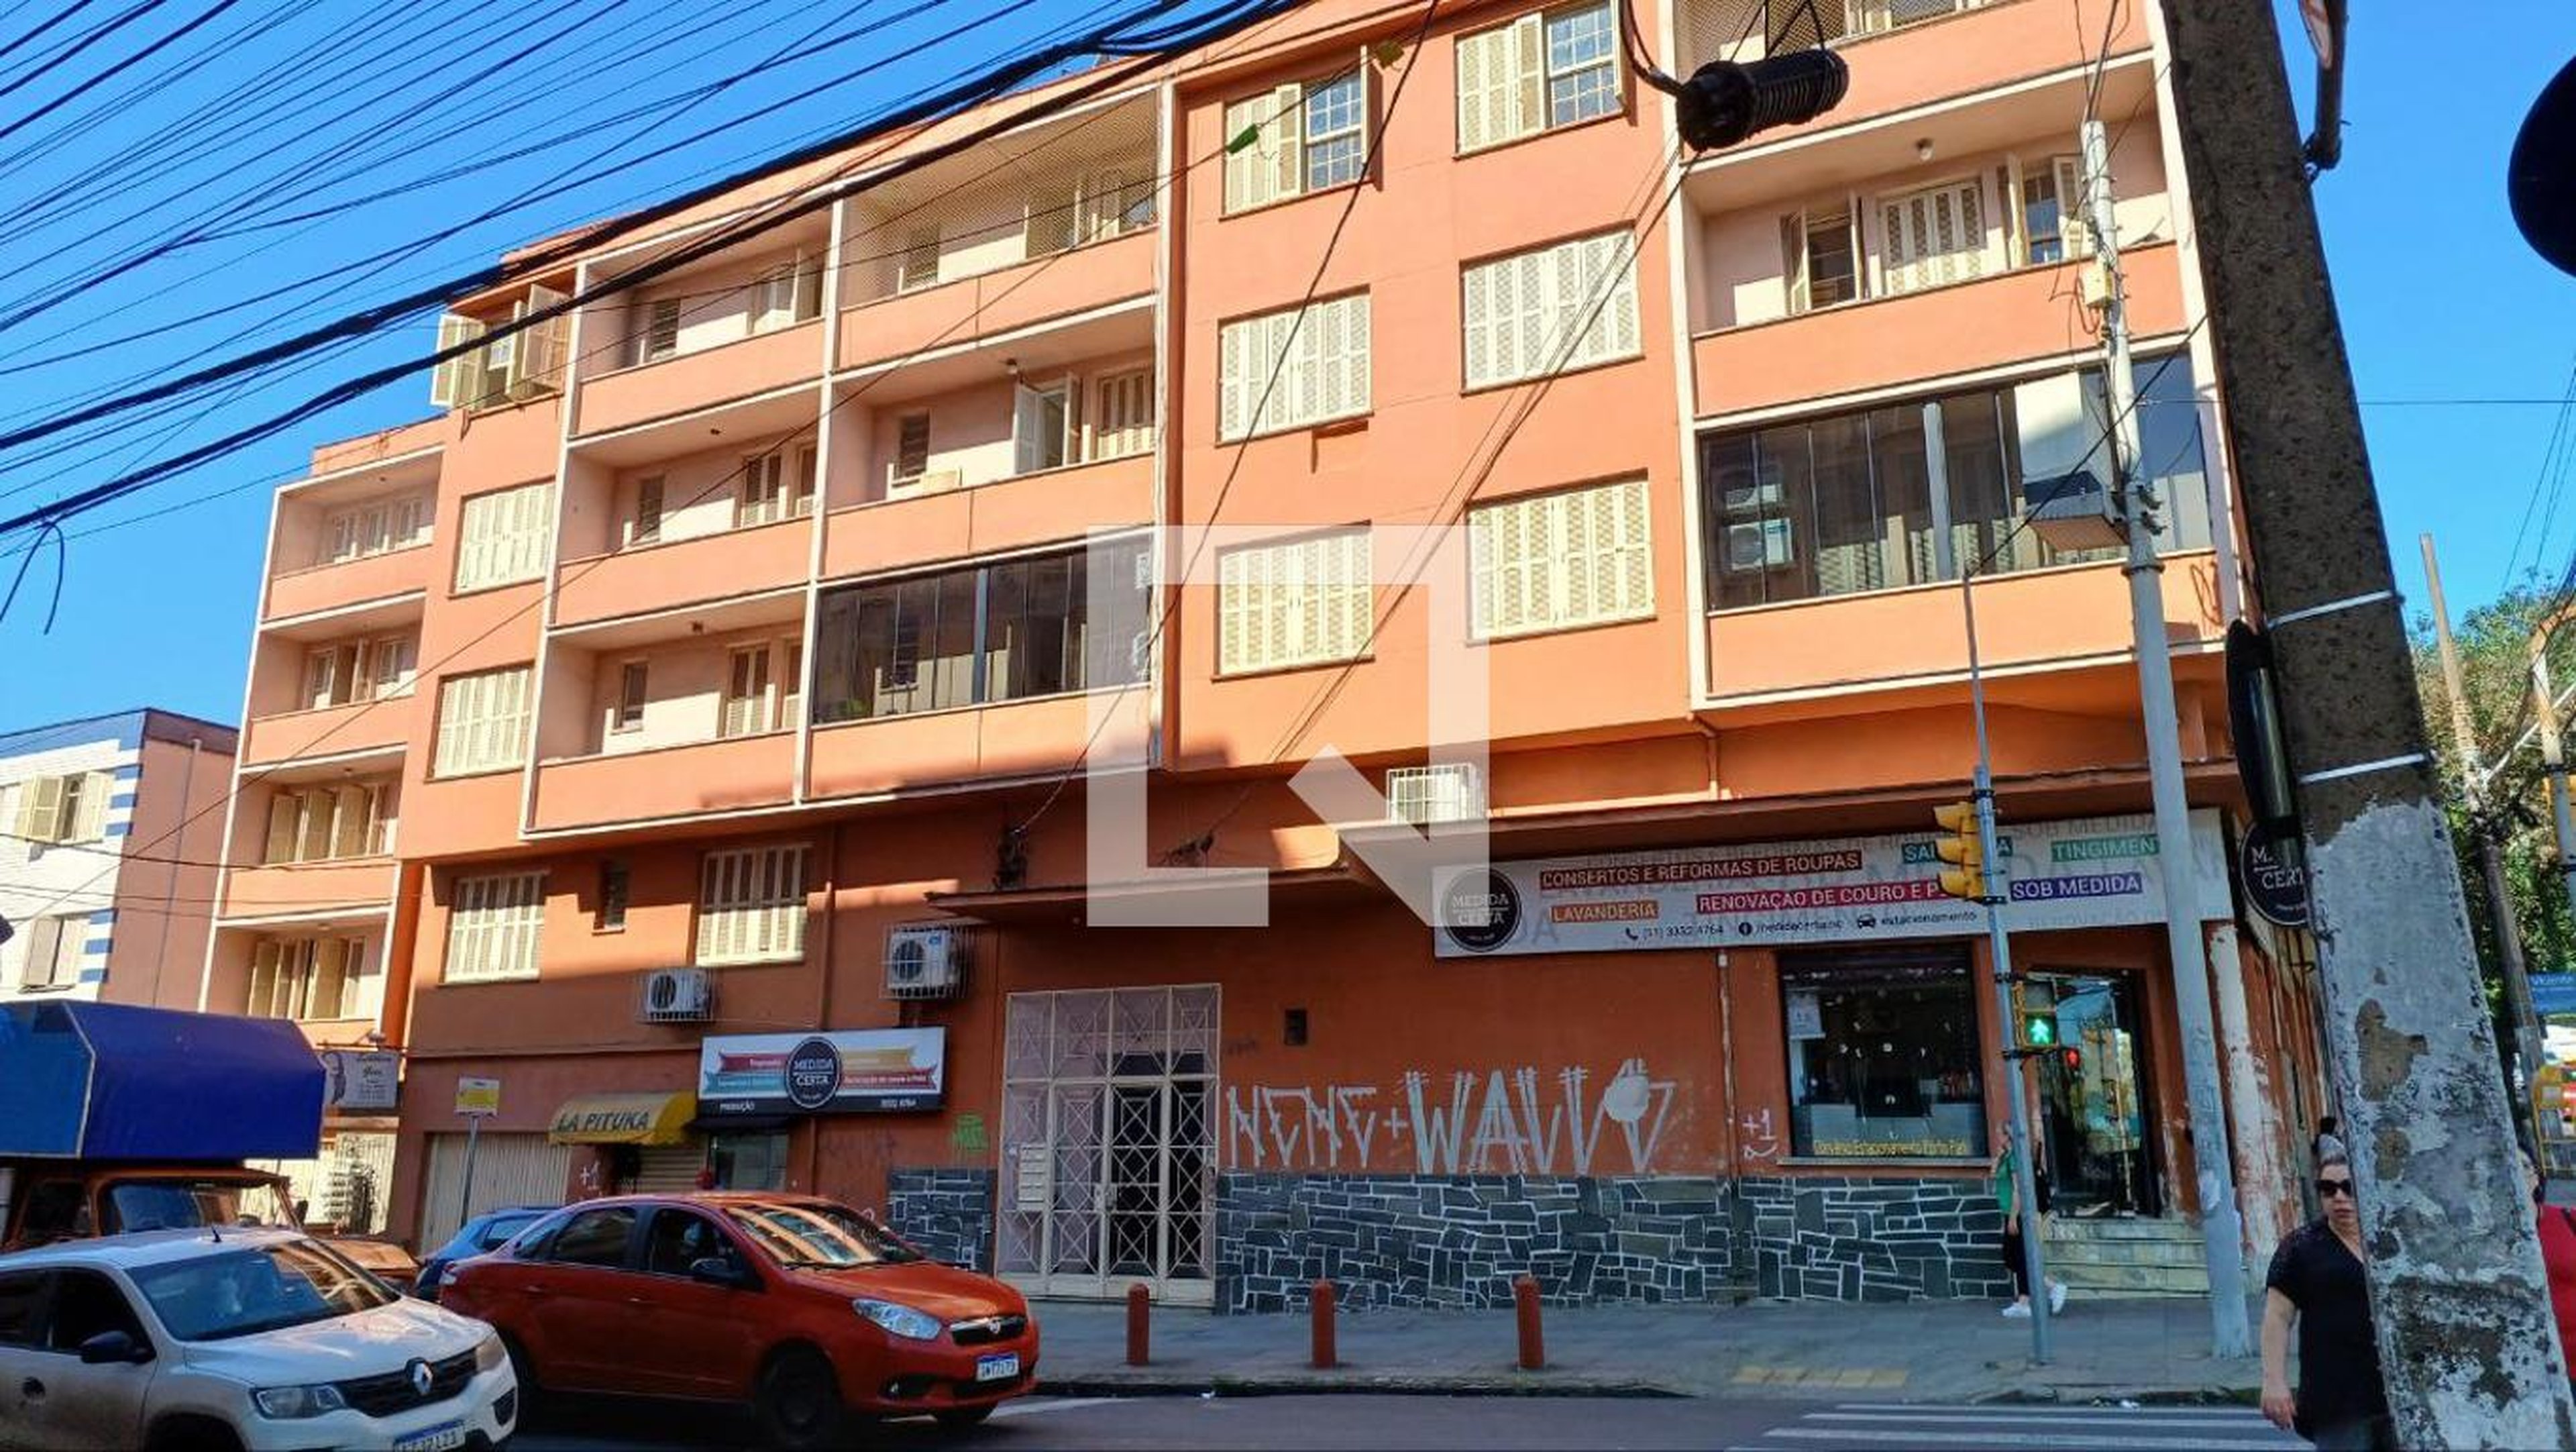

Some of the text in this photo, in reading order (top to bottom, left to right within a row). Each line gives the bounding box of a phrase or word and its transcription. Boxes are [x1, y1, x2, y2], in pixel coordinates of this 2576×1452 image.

[2055, 837, 2156, 861] TINGIMEN
[1543, 853, 1859, 887] CONSERTOS E REFORMAS DE ROUPAS
[1813, 888, 1836, 905] DE
[1840, 886, 1904, 903] COURO
[1912, 883, 1921, 895] E
[2013, 875, 2139, 898] SOB MEDIDA
[1554, 905, 1656, 922] LAVANDERIA
[557, 1110, 650, 1132] LA PITUKA
